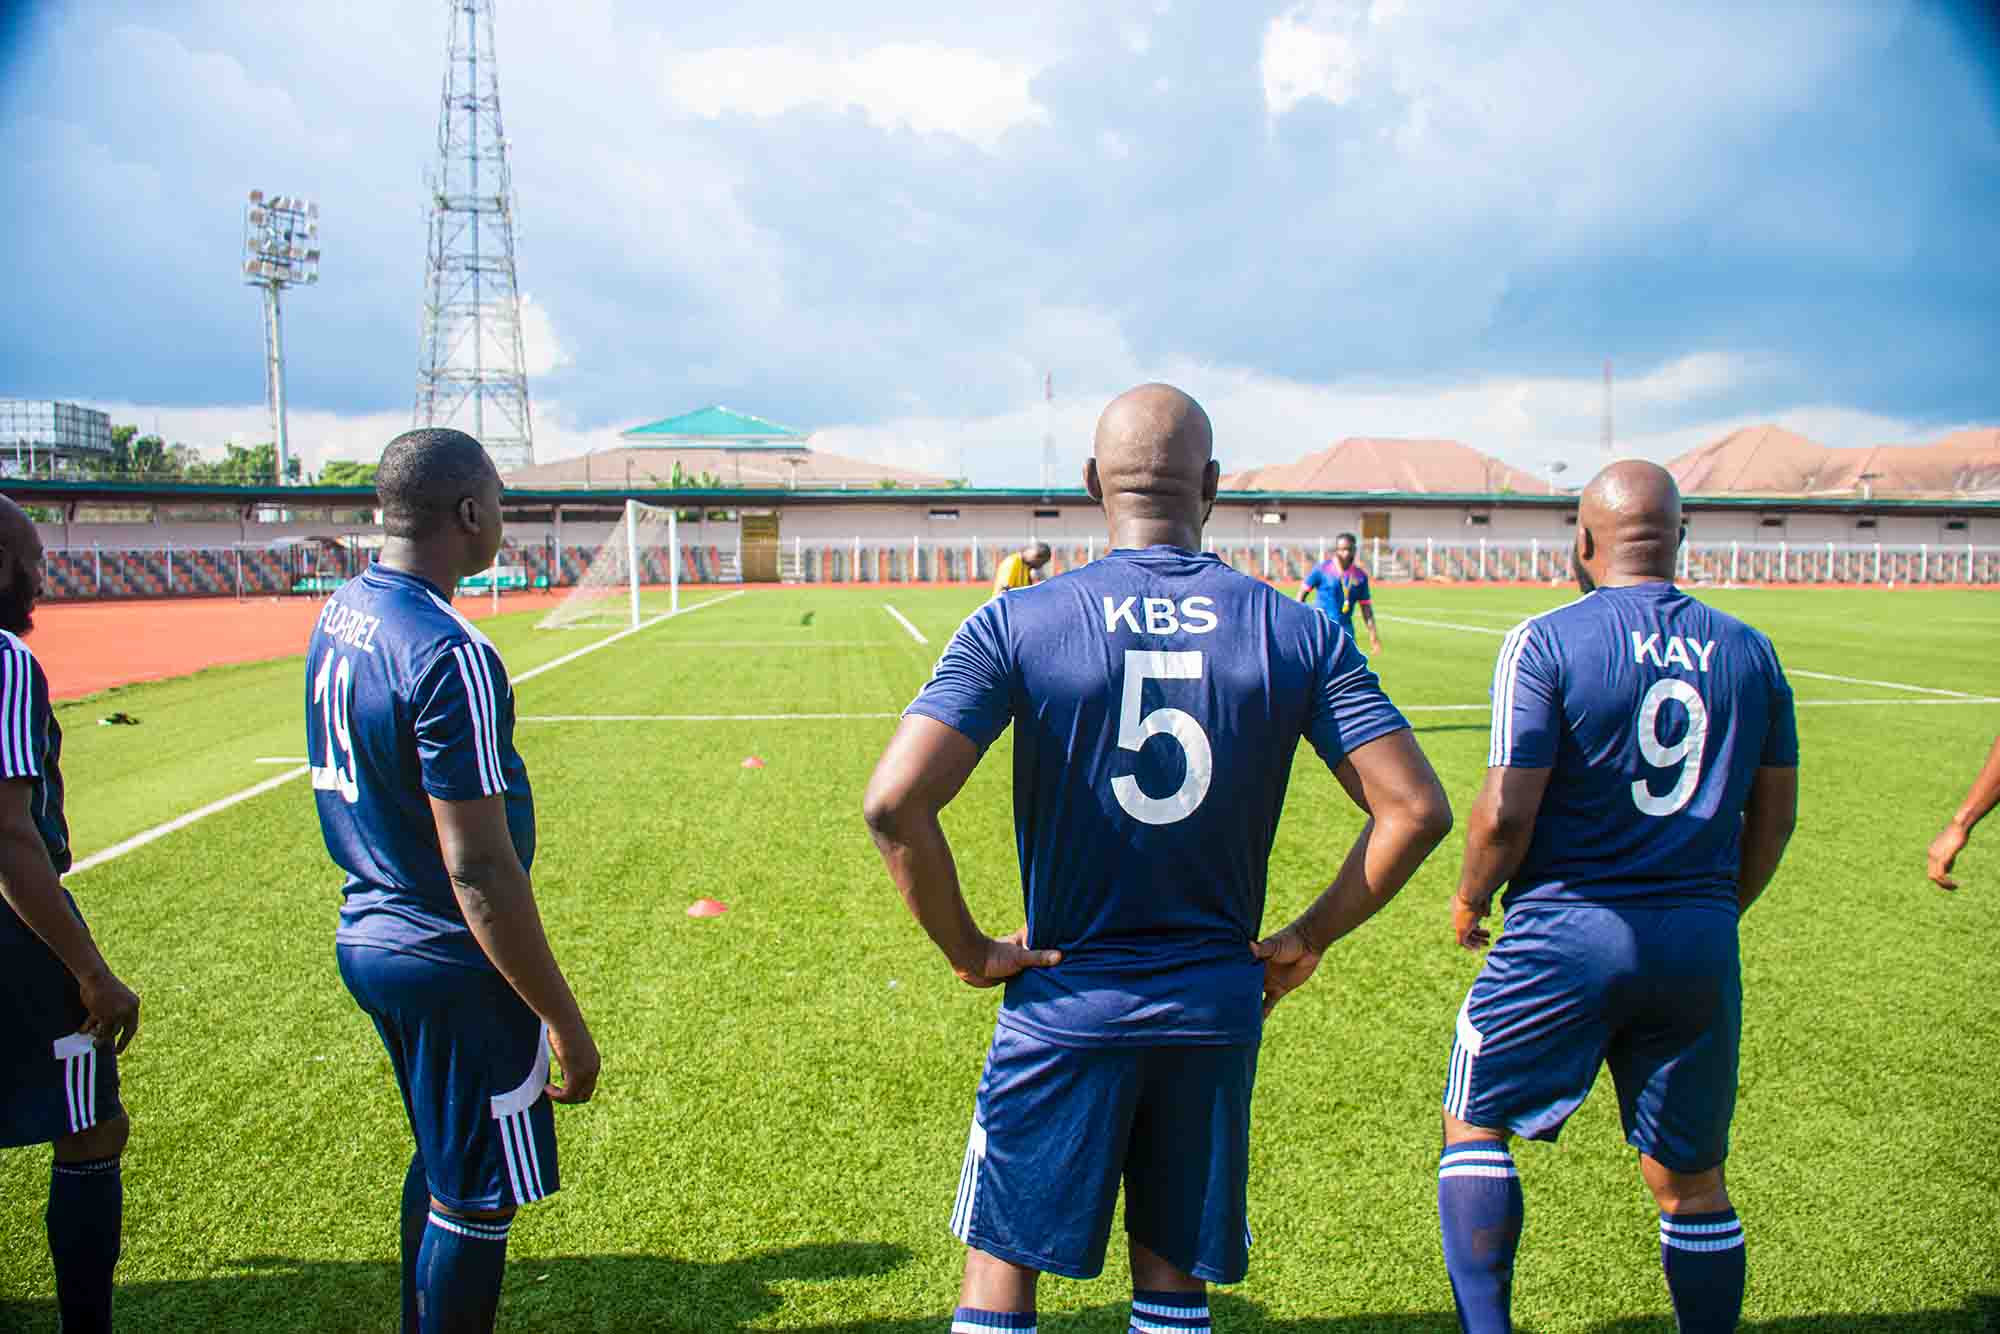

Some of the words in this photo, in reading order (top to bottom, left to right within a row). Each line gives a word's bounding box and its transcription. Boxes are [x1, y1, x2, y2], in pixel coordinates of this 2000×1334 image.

[1103, 596, 1218, 635] KBS
[1631, 631, 1715, 672] KAY
[311, 647, 359, 803] 19
[1111, 649, 1213, 825] 5
[1631, 678, 1709, 816] 9
